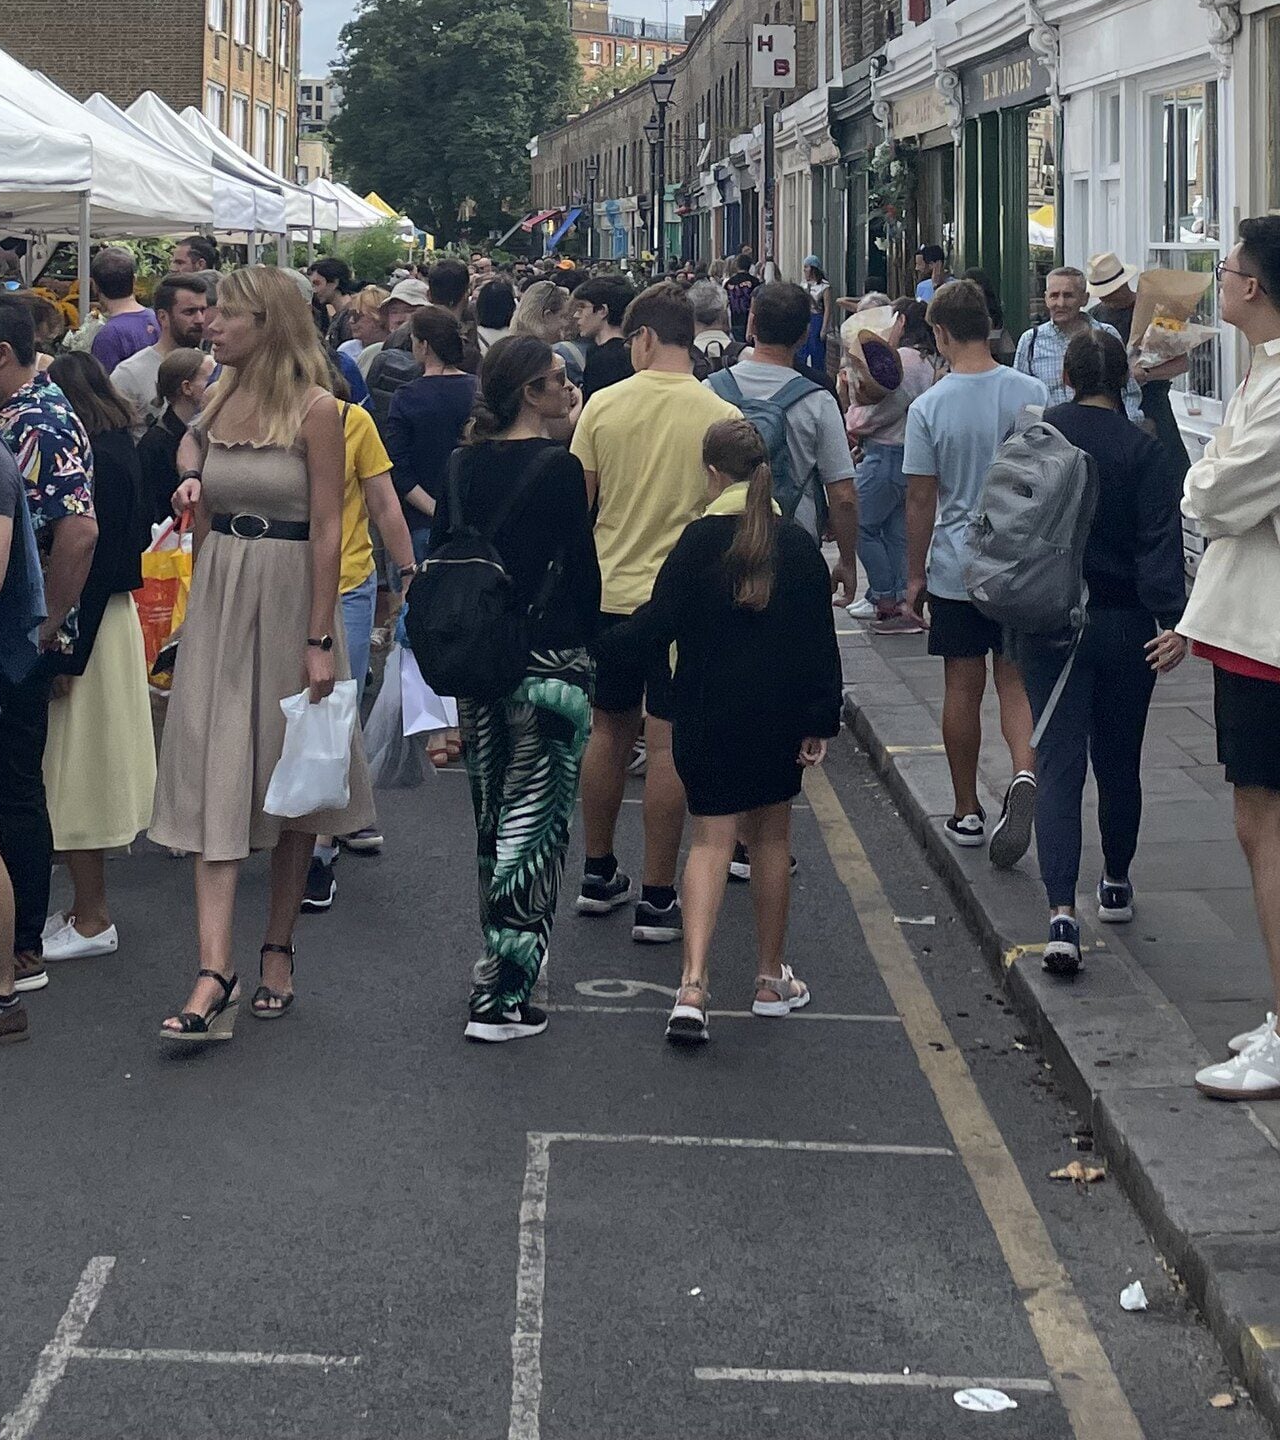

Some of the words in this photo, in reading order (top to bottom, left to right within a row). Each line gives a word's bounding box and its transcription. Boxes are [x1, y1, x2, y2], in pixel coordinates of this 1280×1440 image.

[757, 35, 773, 52] H
[773, 58, 790, 76] B
[1001, 59, 1032, 97] JONES
